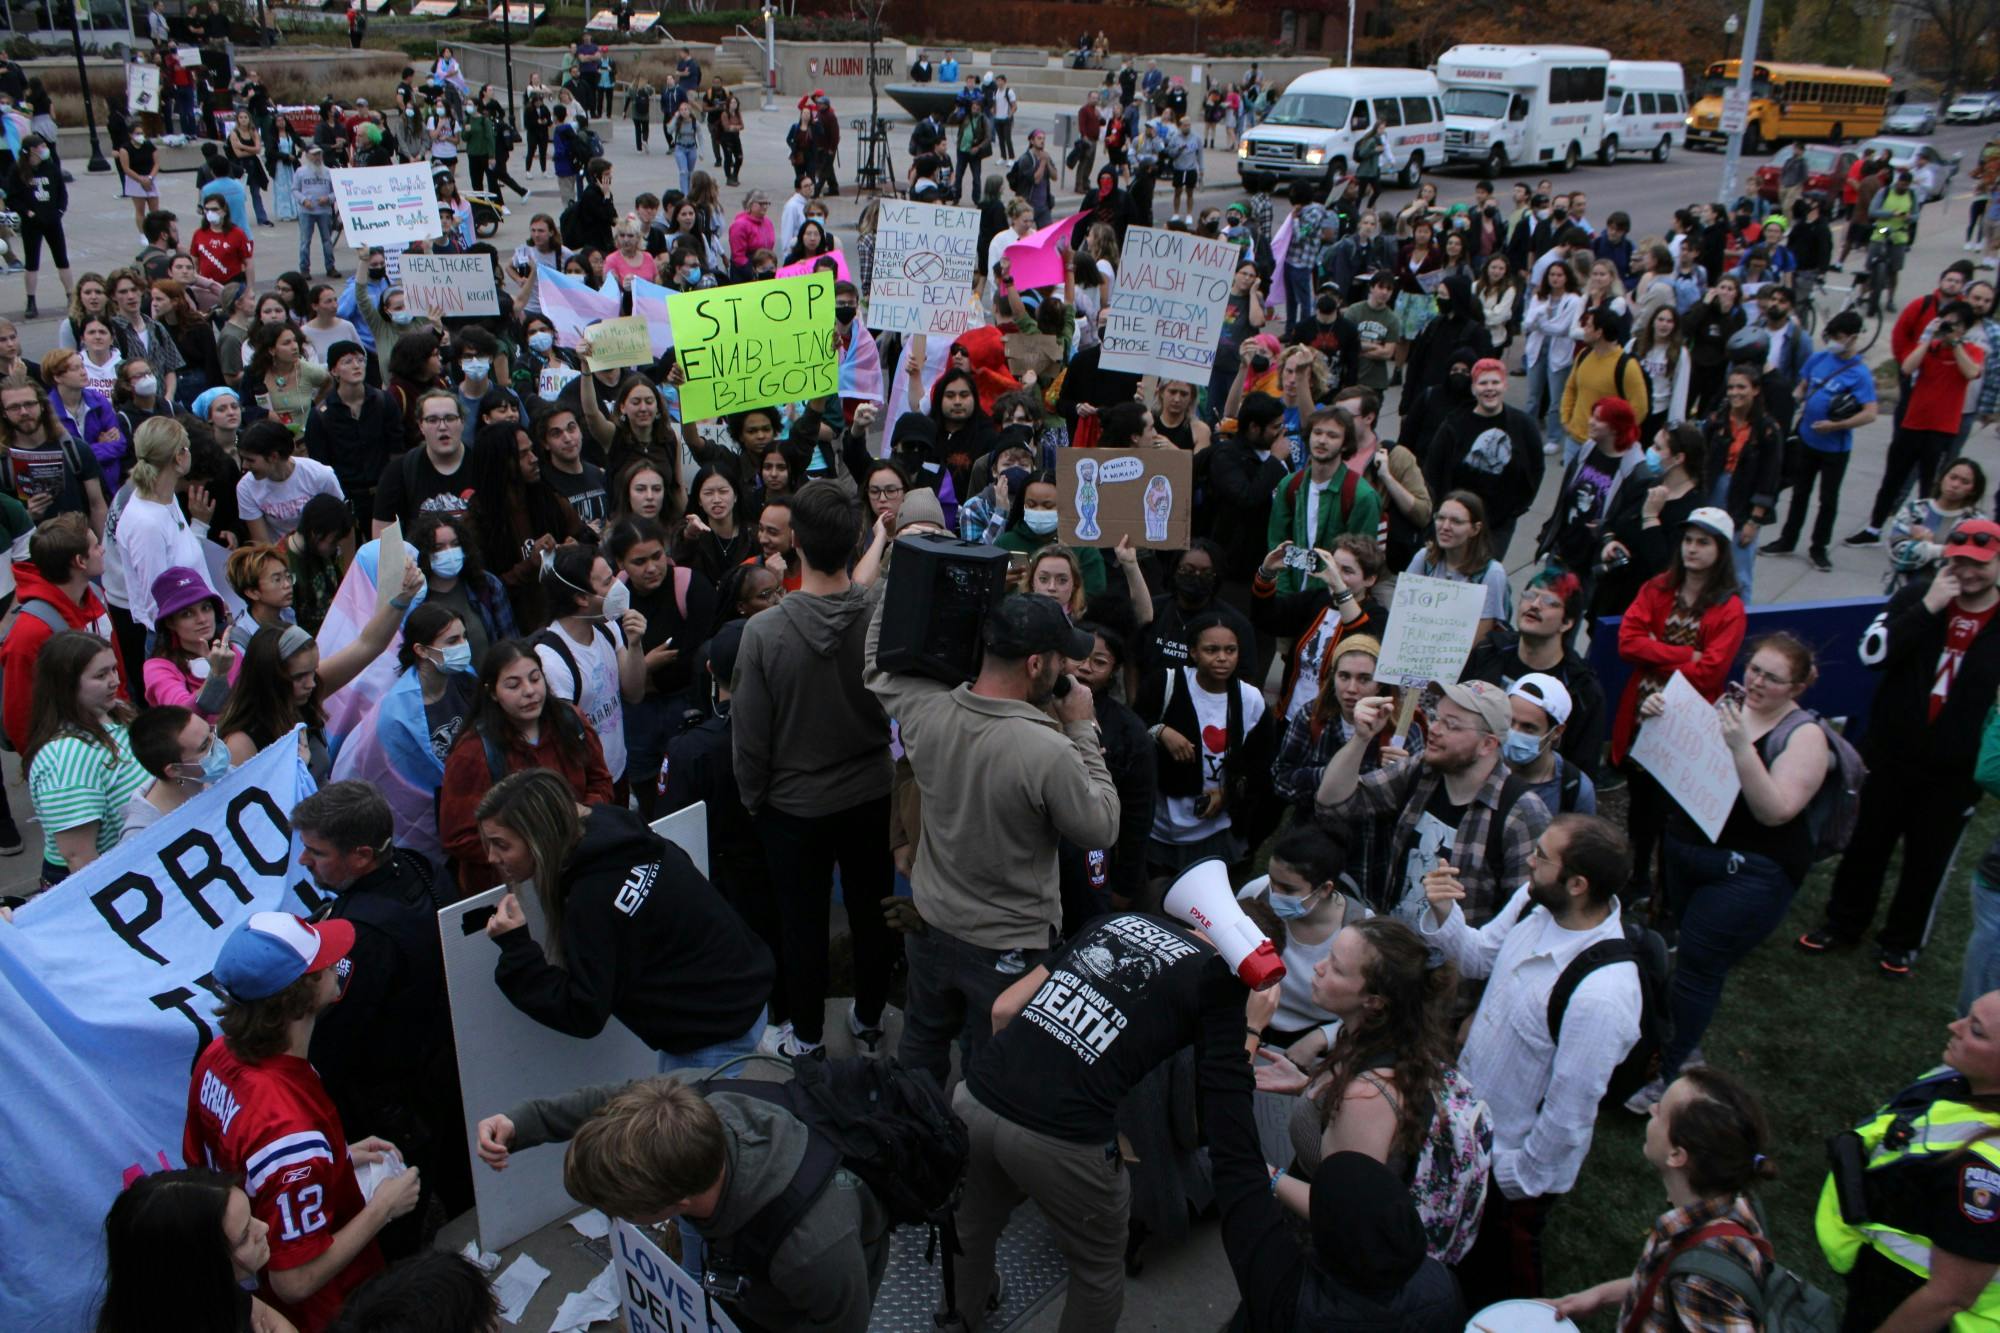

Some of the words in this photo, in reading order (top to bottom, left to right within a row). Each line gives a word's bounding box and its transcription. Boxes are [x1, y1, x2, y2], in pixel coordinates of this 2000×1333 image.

[823, 57, 863, 76] ALUMNI
[866, 57, 894, 76] PARK
[351, 216, 390, 231] Human
[395, 209, 430, 231] Rights
[377, 201, 397, 211] are
[881, 203, 921, 225] WE
[934, 208, 980, 229] BEAT
[877, 229, 929, 250] THEM
[933, 234, 976, 255] ONCE
[1124, 229, 1183, 263] FROM
[1188, 243, 1239, 272] MATT
[408, 257, 484, 273] HEALTHCARE
[432, 275, 442, 285] IS
[445, 274, 453, 285] A
[873, 267, 895, 278] ARE
[922, 285, 971, 307] BEAT
[1120, 260, 1187, 293] WALSH
[1191, 273, 1229, 303] TO
[405, 284, 464, 311] HUMAN
[467, 290, 494, 302] RIGHT
[1111, 292, 1208, 328] ZIONISM
[695, 284, 824, 342] STOP
[869, 303, 922, 331] THEM
[928, 309, 969, 333] AGAIN
[1109, 314, 1147, 333] THE
[1155, 319, 1209, 344] PEOPLE
[1102, 336, 1149, 351] OPPOSE
[1158, 341, 1217, 366] FASCISM
[712, 361, 835, 411] BIGOTS
[1189, 906, 1214, 930] PYLE
[1109, 915, 1197, 960] RESCUE
[1124, 931, 1142, 945] WHO
[1138, 938, 1156, 952] ARE
[1152, 948, 1177, 967] BEING
[1031, 980, 1120, 1054] DEATH
[1077, 983, 1113, 1014] AWAY
[1109, 1006, 1128, 1030] TO
[1021, 1009, 1073, 1046] PROVERBS
[1070, 1039, 1096, 1066] 24:11
[276, 1183, 327, 1242] 12
[618, 1231, 698, 1326] LOVE
